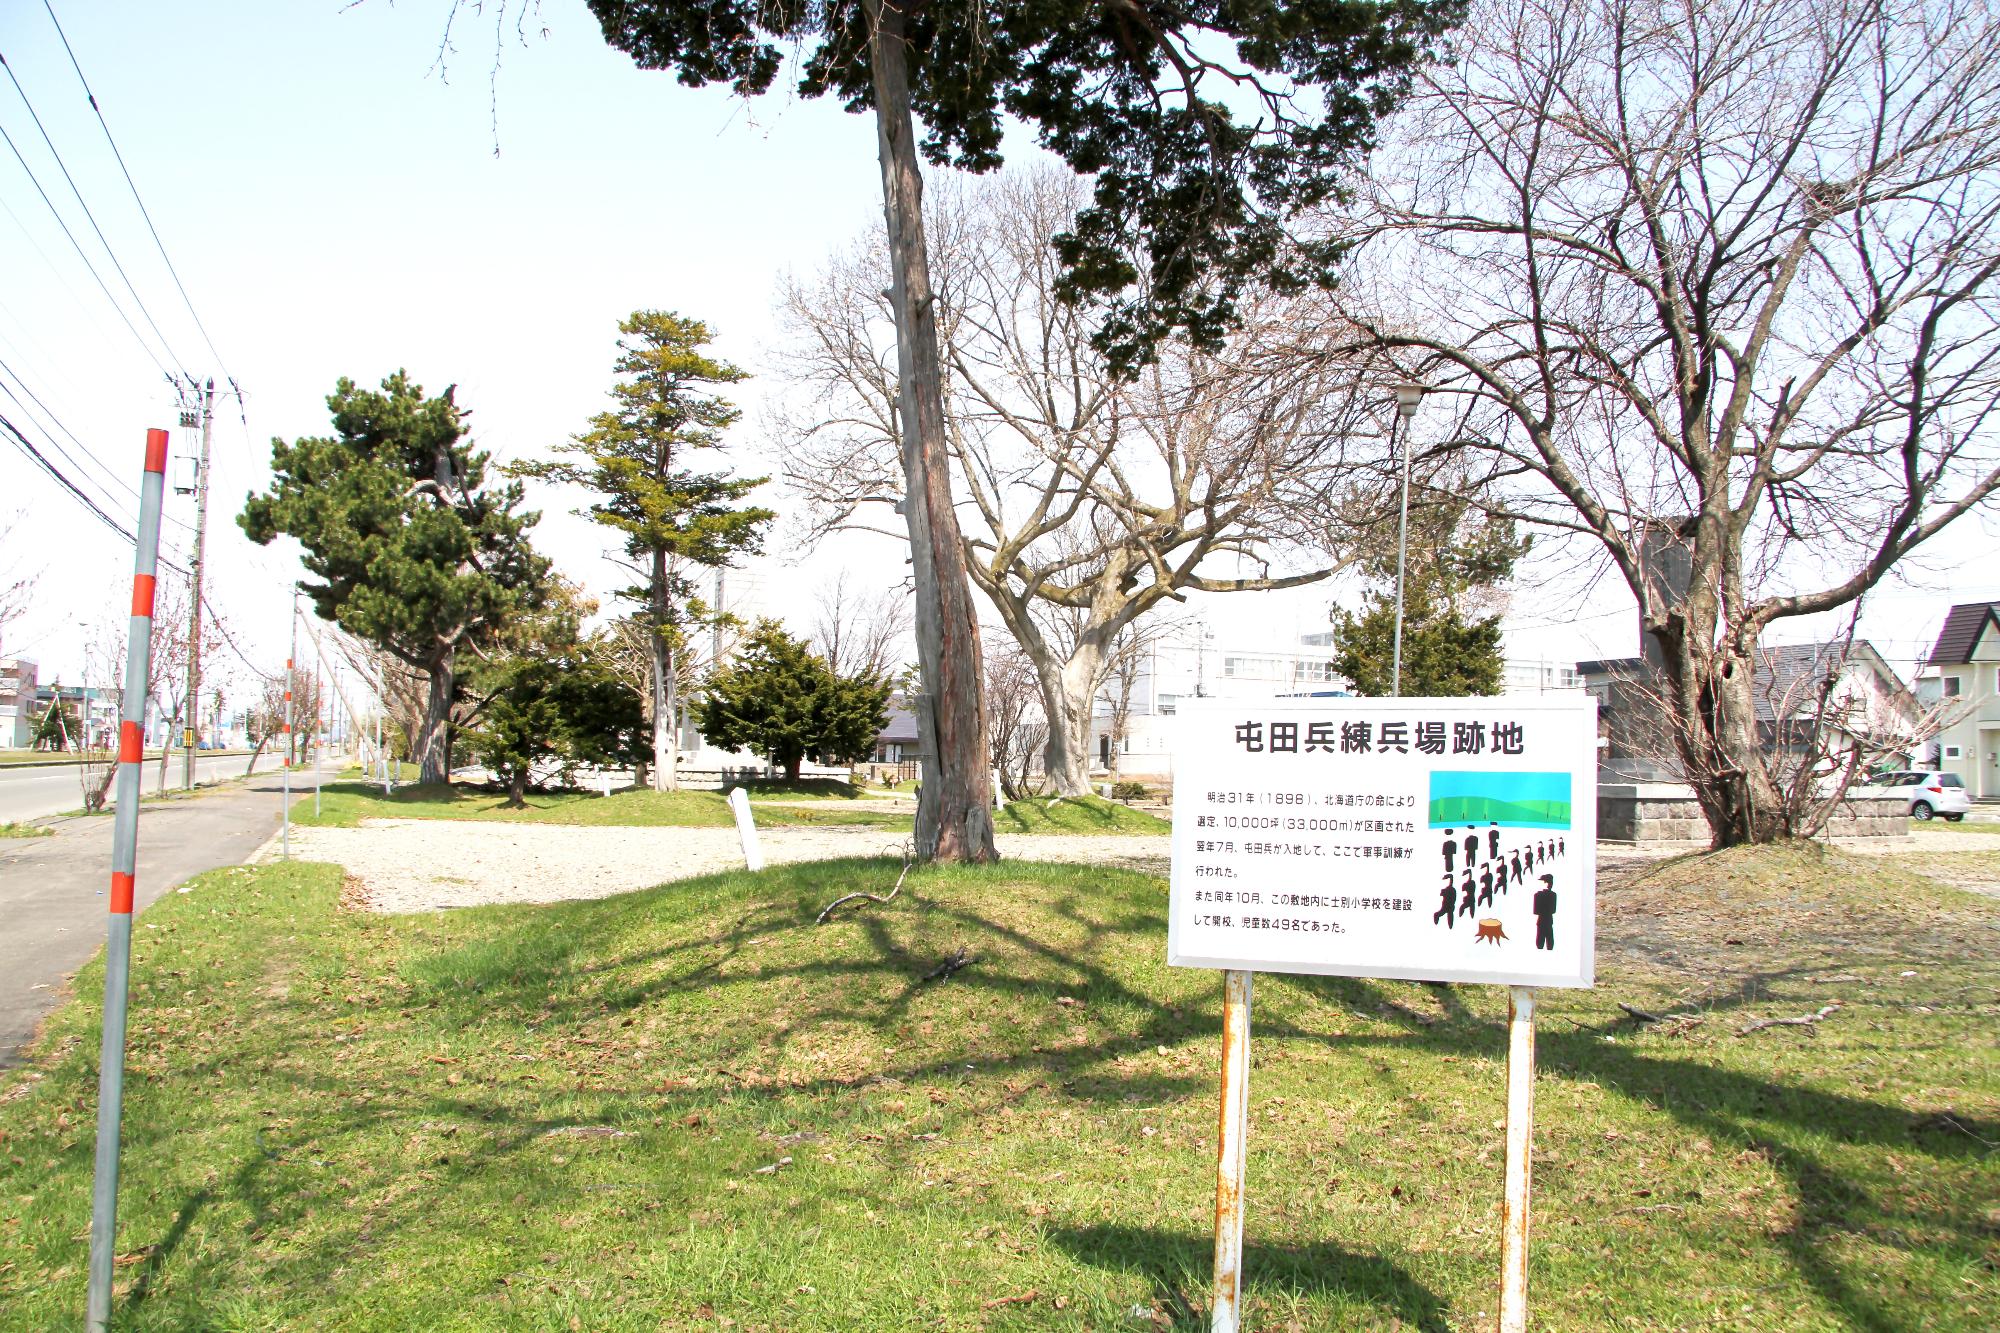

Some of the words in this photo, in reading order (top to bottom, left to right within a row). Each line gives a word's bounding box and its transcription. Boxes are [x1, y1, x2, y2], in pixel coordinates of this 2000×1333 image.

[1235, 721, 1524, 755] 屯田兵練兵場跡地
[1195, 865, 1238, 878] 行われた。
[1194, 913, 1346, 934] して開校、児童数49名であった。
